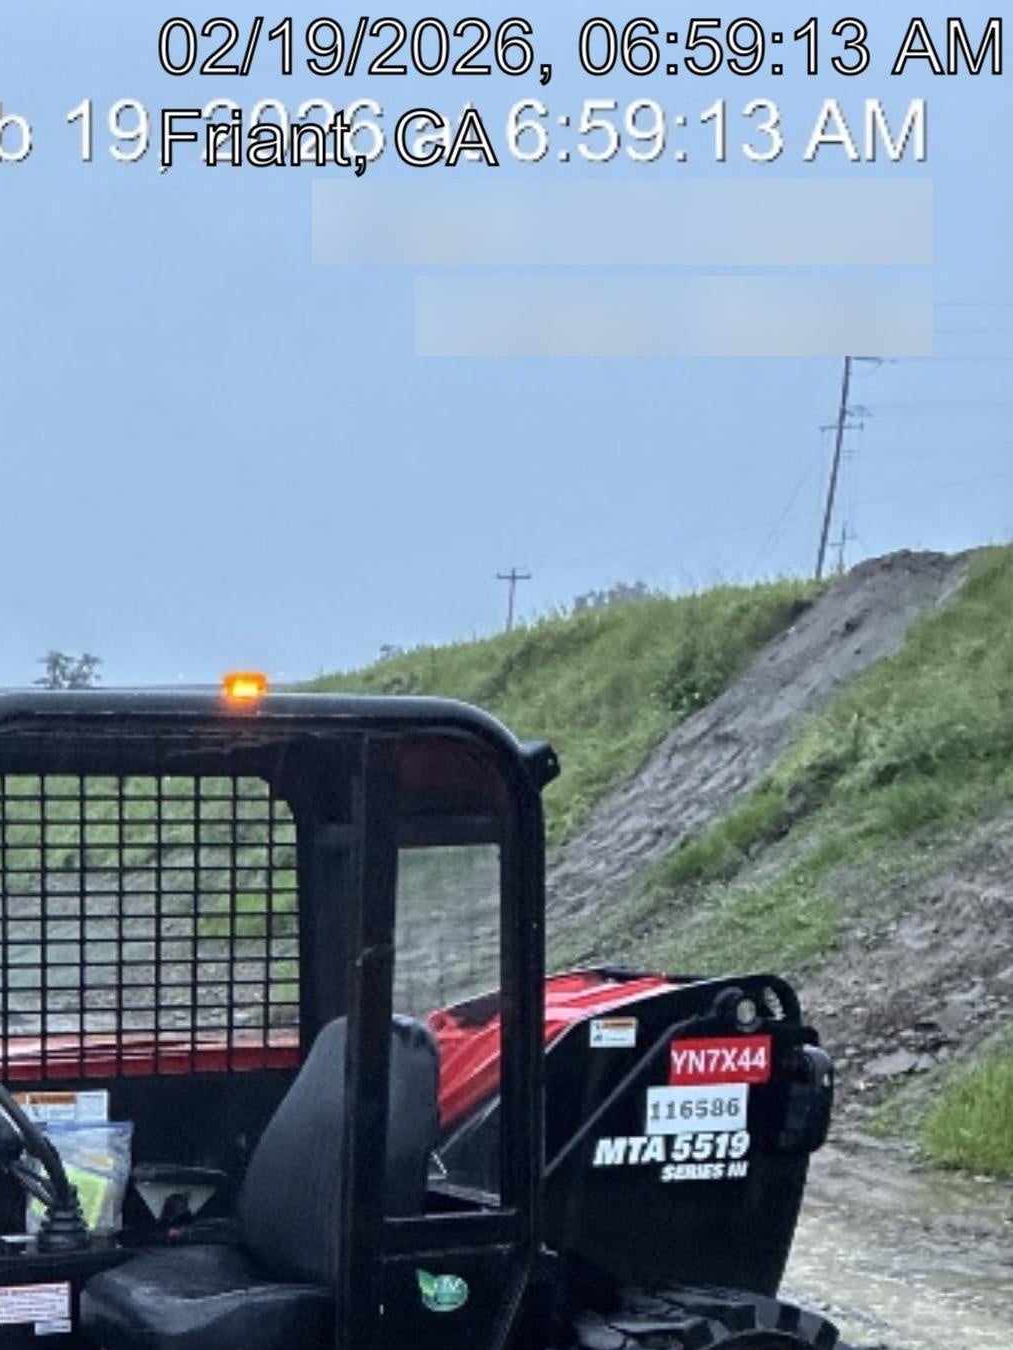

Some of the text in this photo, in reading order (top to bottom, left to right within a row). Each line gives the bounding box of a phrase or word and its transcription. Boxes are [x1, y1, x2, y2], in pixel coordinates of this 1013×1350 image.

[671, 1046, 767, 1075] YN7X44
[593, 1130, 750, 1166] MTA 5519
[661, 1163, 726, 1182] SERIES
